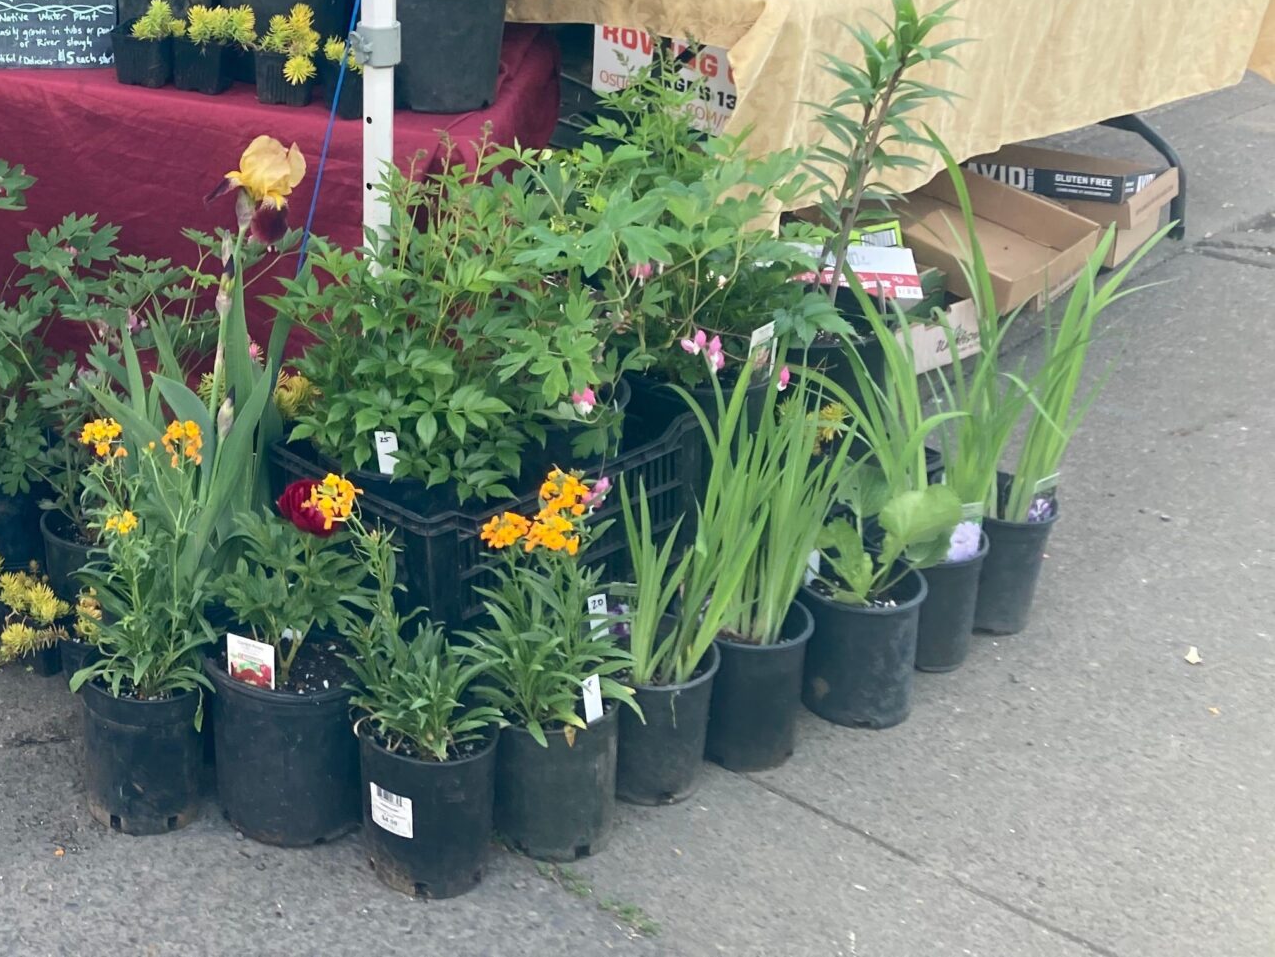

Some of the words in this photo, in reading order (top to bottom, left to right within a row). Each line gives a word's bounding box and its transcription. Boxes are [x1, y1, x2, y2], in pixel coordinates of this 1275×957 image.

[38, 13, 67, 22] Water
[73, 13, 99, 22] Plant
[22, 29, 47, 40] grown
[52, 26, 60, 36] in
[64, 26, 83, 35] tubs
[66, 37, 93, 51] slough
[76, 53, 96, 63] each
[1054, 173, 1089, 185] GLUTEN
[1089, 177, 1113, 187] FREE
[590, 598, 604, 610] 20
